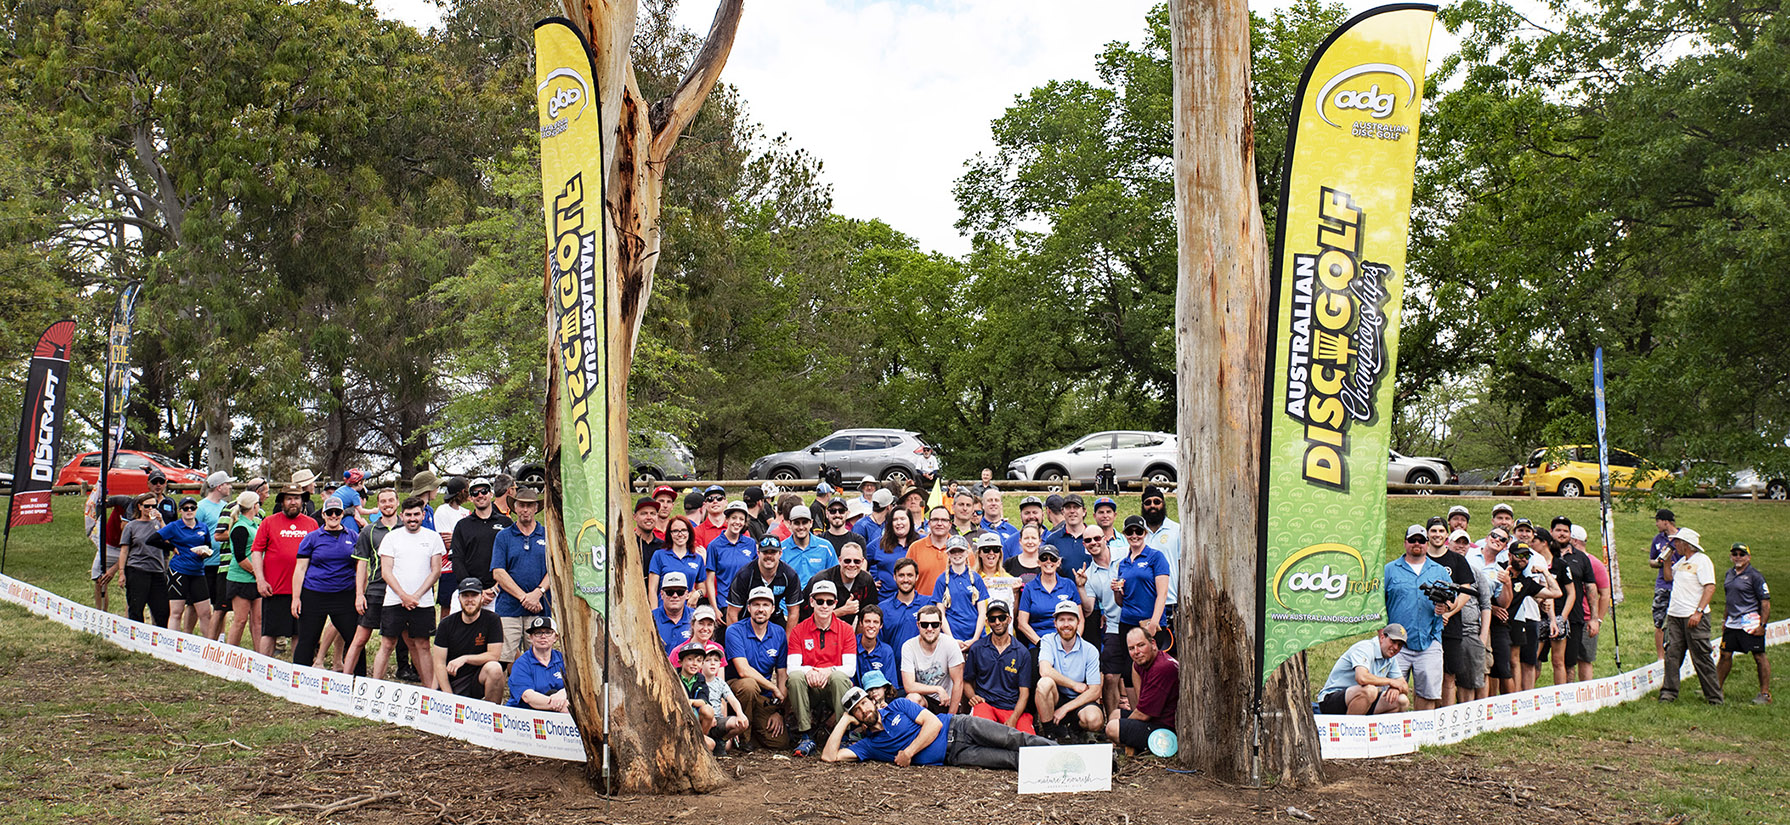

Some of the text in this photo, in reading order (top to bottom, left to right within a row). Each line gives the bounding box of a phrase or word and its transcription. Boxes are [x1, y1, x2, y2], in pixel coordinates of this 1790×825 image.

[1334, 84, 1395, 118] adg
[1351, 128, 1400, 140] DISC GOLF
[1352, 121, 1409, 134] AUSTRALIAN
[1287, 257, 1315, 418] AUSTRALIAN
[1306, 190, 1362, 485] DISC GOLF
[1340, 262, 1387, 420] Championships
[31, 368, 59, 482] DISCRAFT
[1288, 565, 1380, 598] adg TOUR
[1271, 613, 1381, 623] WWW.AUSTRALIANDISCGOLF.COM
[158, 633, 175, 647] Choices
[183, 639, 201, 653] Choices
[252, 659, 266, 674] Choices
[273, 665, 290, 682] Choices
[300, 672, 320, 688] Choices
[330, 679, 351, 694] Choices
[430, 697, 452, 715] Choices
[465, 706, 492, 725] Choices
[502, 714, 531, 732] Choices
[545, 720, 580, 737] Choices
[1340, 723, 1366, 736] Choices
[1378, 722, 1401, 736] Choices
[1412, 719, 1434, 731] Choices
